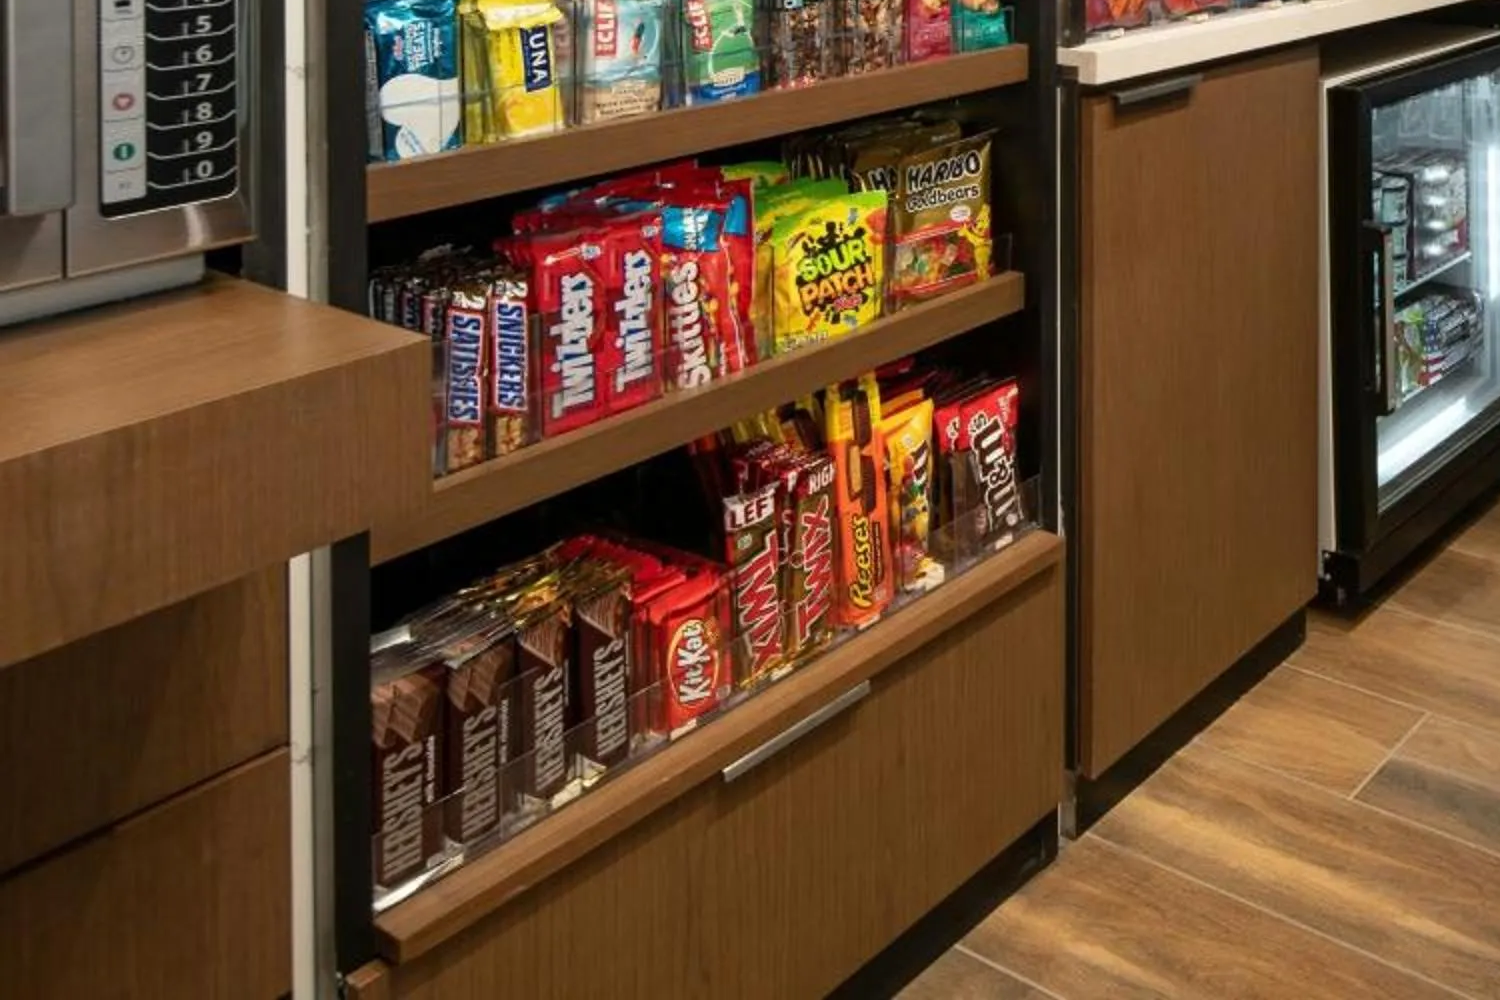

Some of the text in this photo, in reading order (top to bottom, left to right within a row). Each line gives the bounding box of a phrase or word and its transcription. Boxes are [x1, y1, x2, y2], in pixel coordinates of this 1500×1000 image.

[195, 15, 212, 34] 5
[195, 44, 212, 64] 6
[196, 74, 212, 93] 7
[196, 102, 212, 121] 8
[196, 131, 212, 151] 9
[196, 160, 212, 179] 0
[907, 150, 981, 192] HARIBO
[801, 240, 865, 281] SOUR
[801, 265, 874, 310] PATCH
[671, 261, 712, 389] Skittles
[497, 303, 527, 409] SNICKERS
